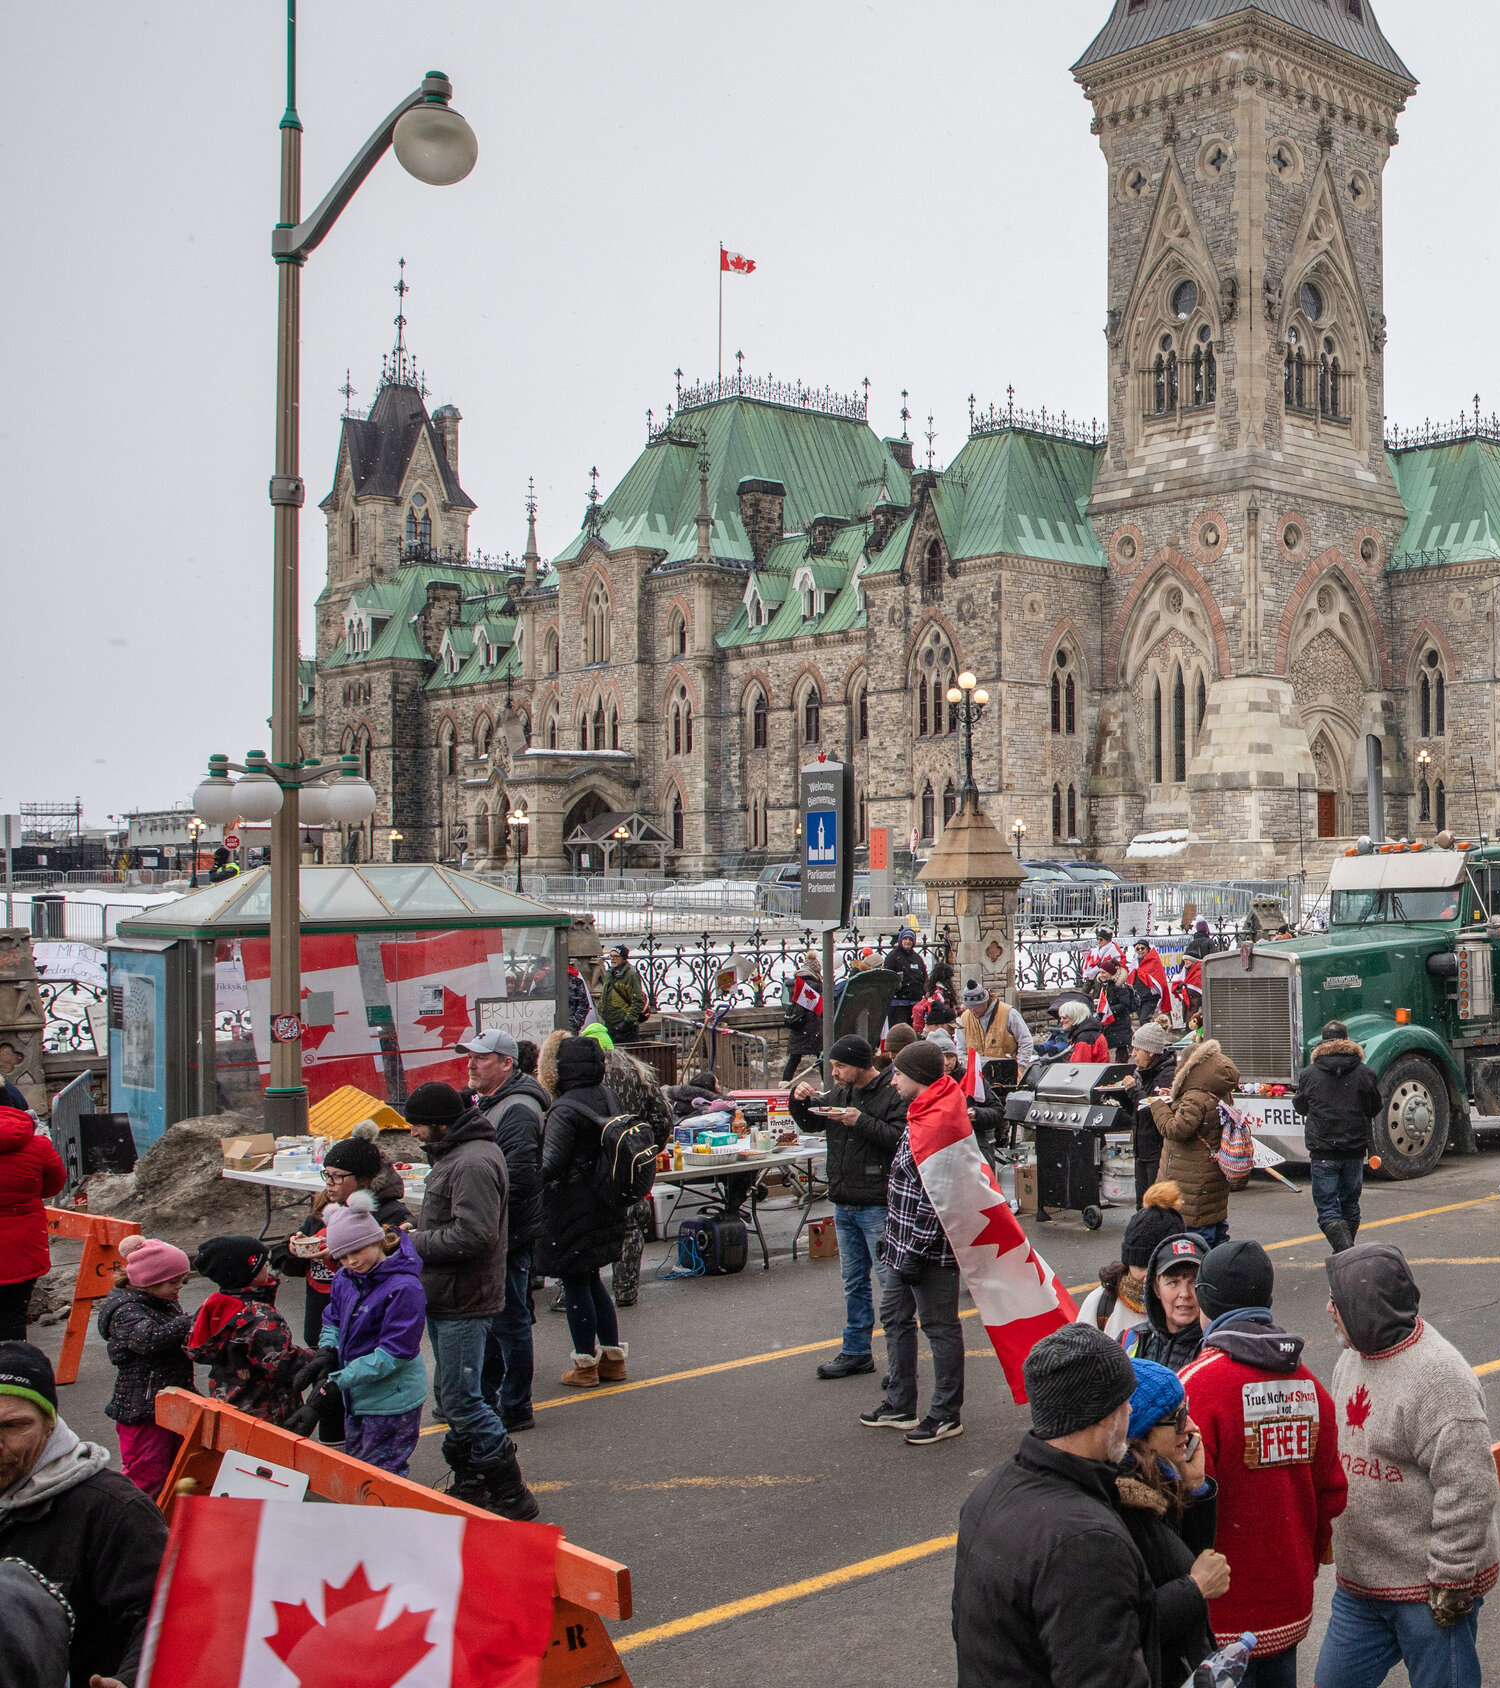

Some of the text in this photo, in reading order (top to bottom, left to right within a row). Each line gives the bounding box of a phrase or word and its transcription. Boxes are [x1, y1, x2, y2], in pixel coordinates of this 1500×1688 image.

[808, 781, 835, 792] Welcome
[808, 796, 836, 807] Bienvenue
[807, 870, 836, 880] Parliament
[808, 883, 836, 893] Parlement
[57, 943, 99, 963] MERCI
[1157, 945, 1184, 954] ANADA
[482, 1001, 534, 1020] BRING
[1264, 1108, 1305, 1126] FREE
[1280, 1343, 1295, 1352] HH
[0, 1373, 30, 1384] ap-on
[1244, 1394, 1267, 1406] True
[1262, 1424, 1309, 1459] FREE
[1338, 1451, 1404, 1483] nada
